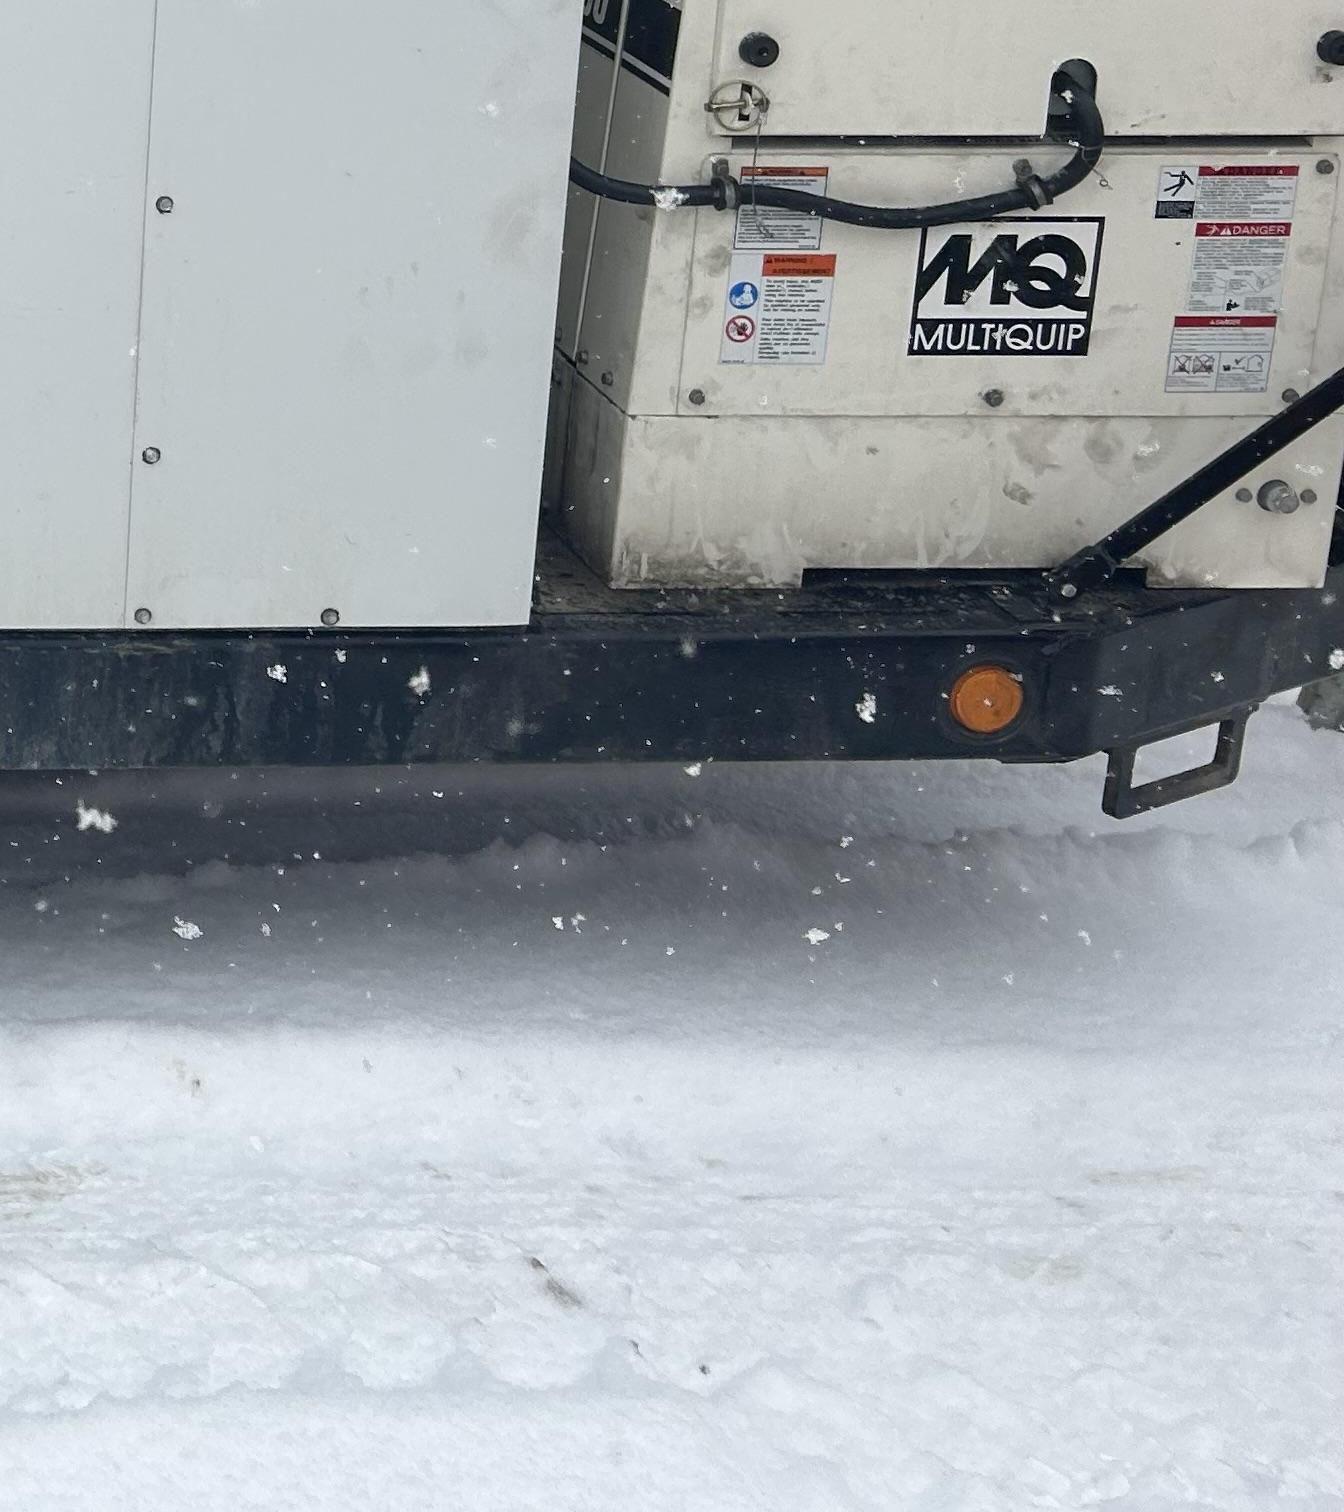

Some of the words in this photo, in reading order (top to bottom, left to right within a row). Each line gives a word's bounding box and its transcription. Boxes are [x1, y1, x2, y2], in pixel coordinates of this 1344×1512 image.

[1232, 225, 1286, 235] DANGER
[916, 233, 1091, 312] MQ
[912, 323, 1086, 351] MULTIQUIP
